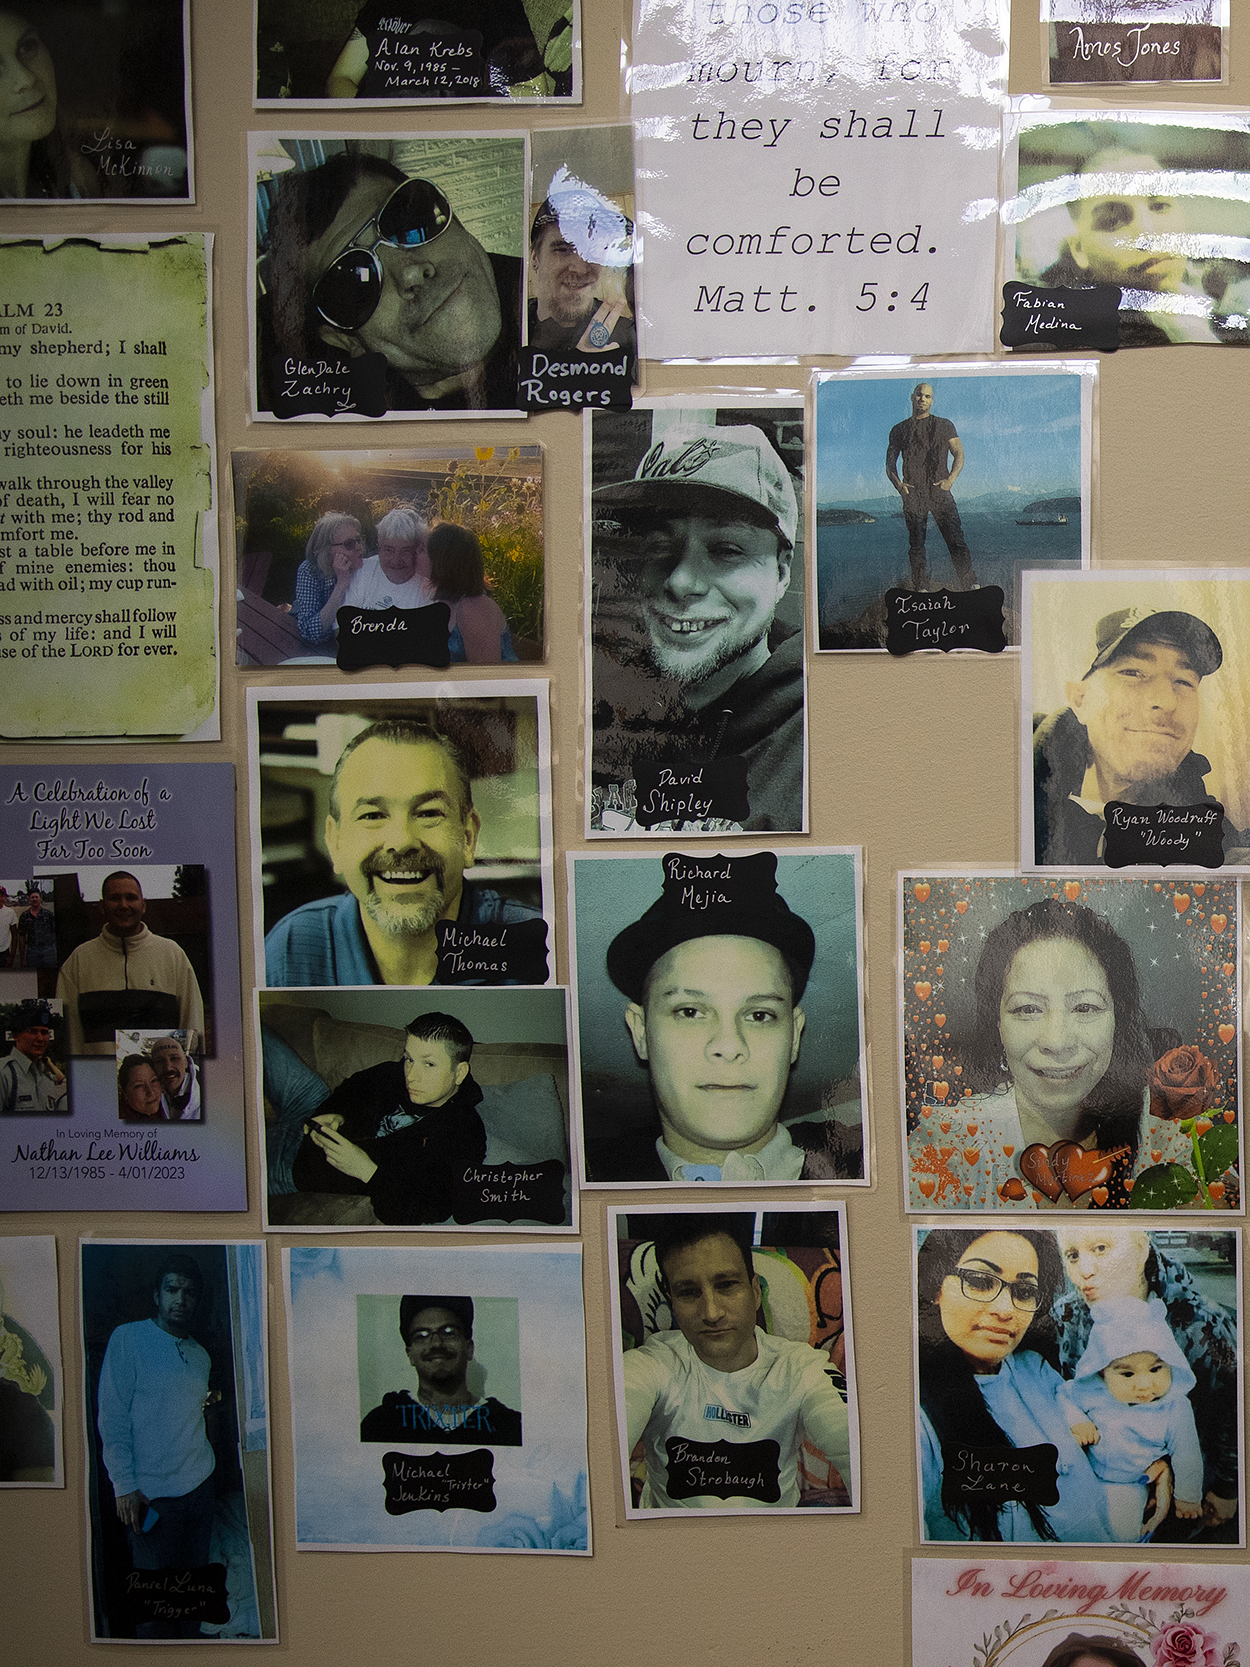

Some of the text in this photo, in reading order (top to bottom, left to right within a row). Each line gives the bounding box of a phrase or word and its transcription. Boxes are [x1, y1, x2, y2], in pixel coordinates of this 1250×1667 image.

[375, 37, 473, 58] Alan Krebs
[1069, 24, 1180, 66] Amos Jones
[374, 60, 399, 72] Nov.
[420, 62, 447, 73] 1985
[384, 76, 430, 88] March
[692, 109, 946, 147] they shall
[81, 127, 137, 154] Lisa
[97, 154, 174, 177] McKinnon
[789, 169, 841, 197] be
[686, 225, 937, 255] comforted.
[693, 282, 930, 312] Matt. 5:4
[1013, 291, 1065, 310] Fabian
[1025, 314, 1082, 334] Medina
[532, 353, 628, 379] Desmond
[281, 381, 352, 402] Zachry
[520, 379, 611, 406] Rogers
[4, 441, 172, 458] righteousness for his
[895, 596, 956, 616] Isaiah
[350, 615, 408, 634] Brenda
[902, 620, 969, 643] Taylor
[659, 769, 702, 787] David
[8, 777, 171, 807] A Celebration of a
[642, 788, 713, 816] Shipley
[30, 808, 156, 838] Light We Lost
[1112, 807, 1218, 828] Ryan Woodruff
[36, 839, 152, 860] Far Too Soon
[668, 857, 732, 880] Richard
[681, 886, 732, 910] Mejia
[442, 927, 507, 947] Michael
[443, 951, 508, 973] Thomas
[56, 1128, 158, 1141] In Loving Memory of
[11, 1140, 200, 1164] Nathan Lee Williams
[30, 1167, 106, 1180] 12/13/1985
[118, 1166, 185, 1180] 4/01/2023
[463, 1168, 543, 1187] Christopher
[480, 1189, 530, 1203] Smith
[706, 1405, 750, 1426] HOLLISTER
[671, 1443, 731, 1465] Brandon
[952, 1450, 1034, 1474] Sharon
[686, 1467, 764, 1488] Strobaugh
[961, 1476, 1026, 1492] Lane
[946, 1568, 1228, 1616] In Loving Memory
